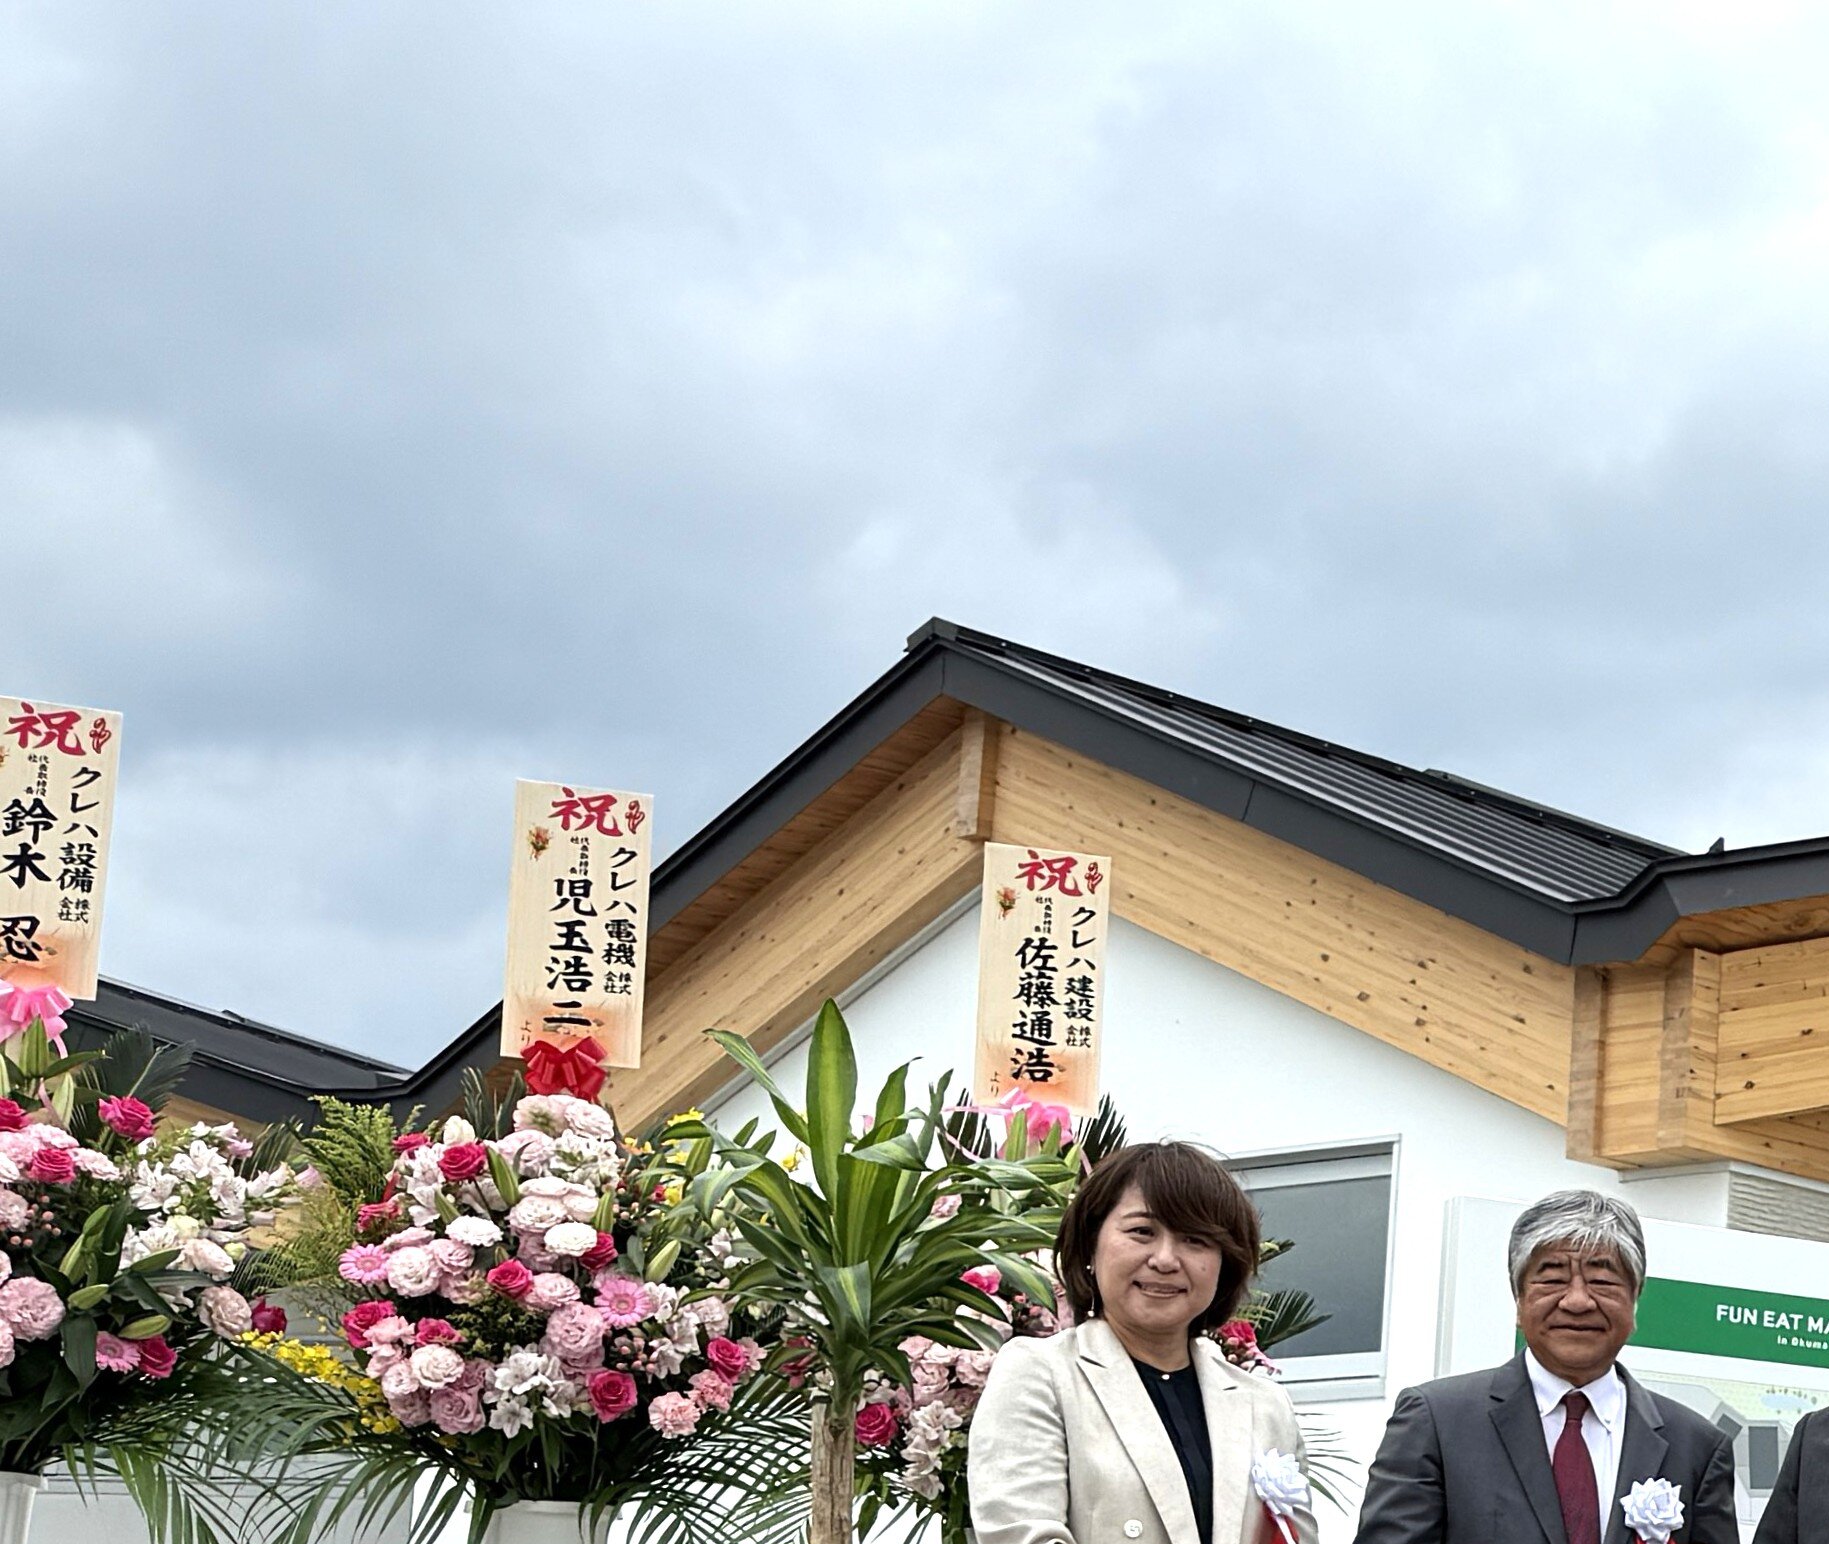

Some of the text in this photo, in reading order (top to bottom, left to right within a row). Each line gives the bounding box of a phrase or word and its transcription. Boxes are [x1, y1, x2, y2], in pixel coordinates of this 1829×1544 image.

[4, 701, 87, 757] 祝
[548, 786, 624, 837] 祝
[1014, 850, 1084, 897] 祝
[543, 878, 598, 1028] 児玉浩二
[1009, 936, 1061, 1083] 佐藤通浩
[1716, 1304, 1758, 1326] FUN
[1763, 1310, 1803, 1331] EAT
[1777, 1335, 1828, 1350] in Okuma
